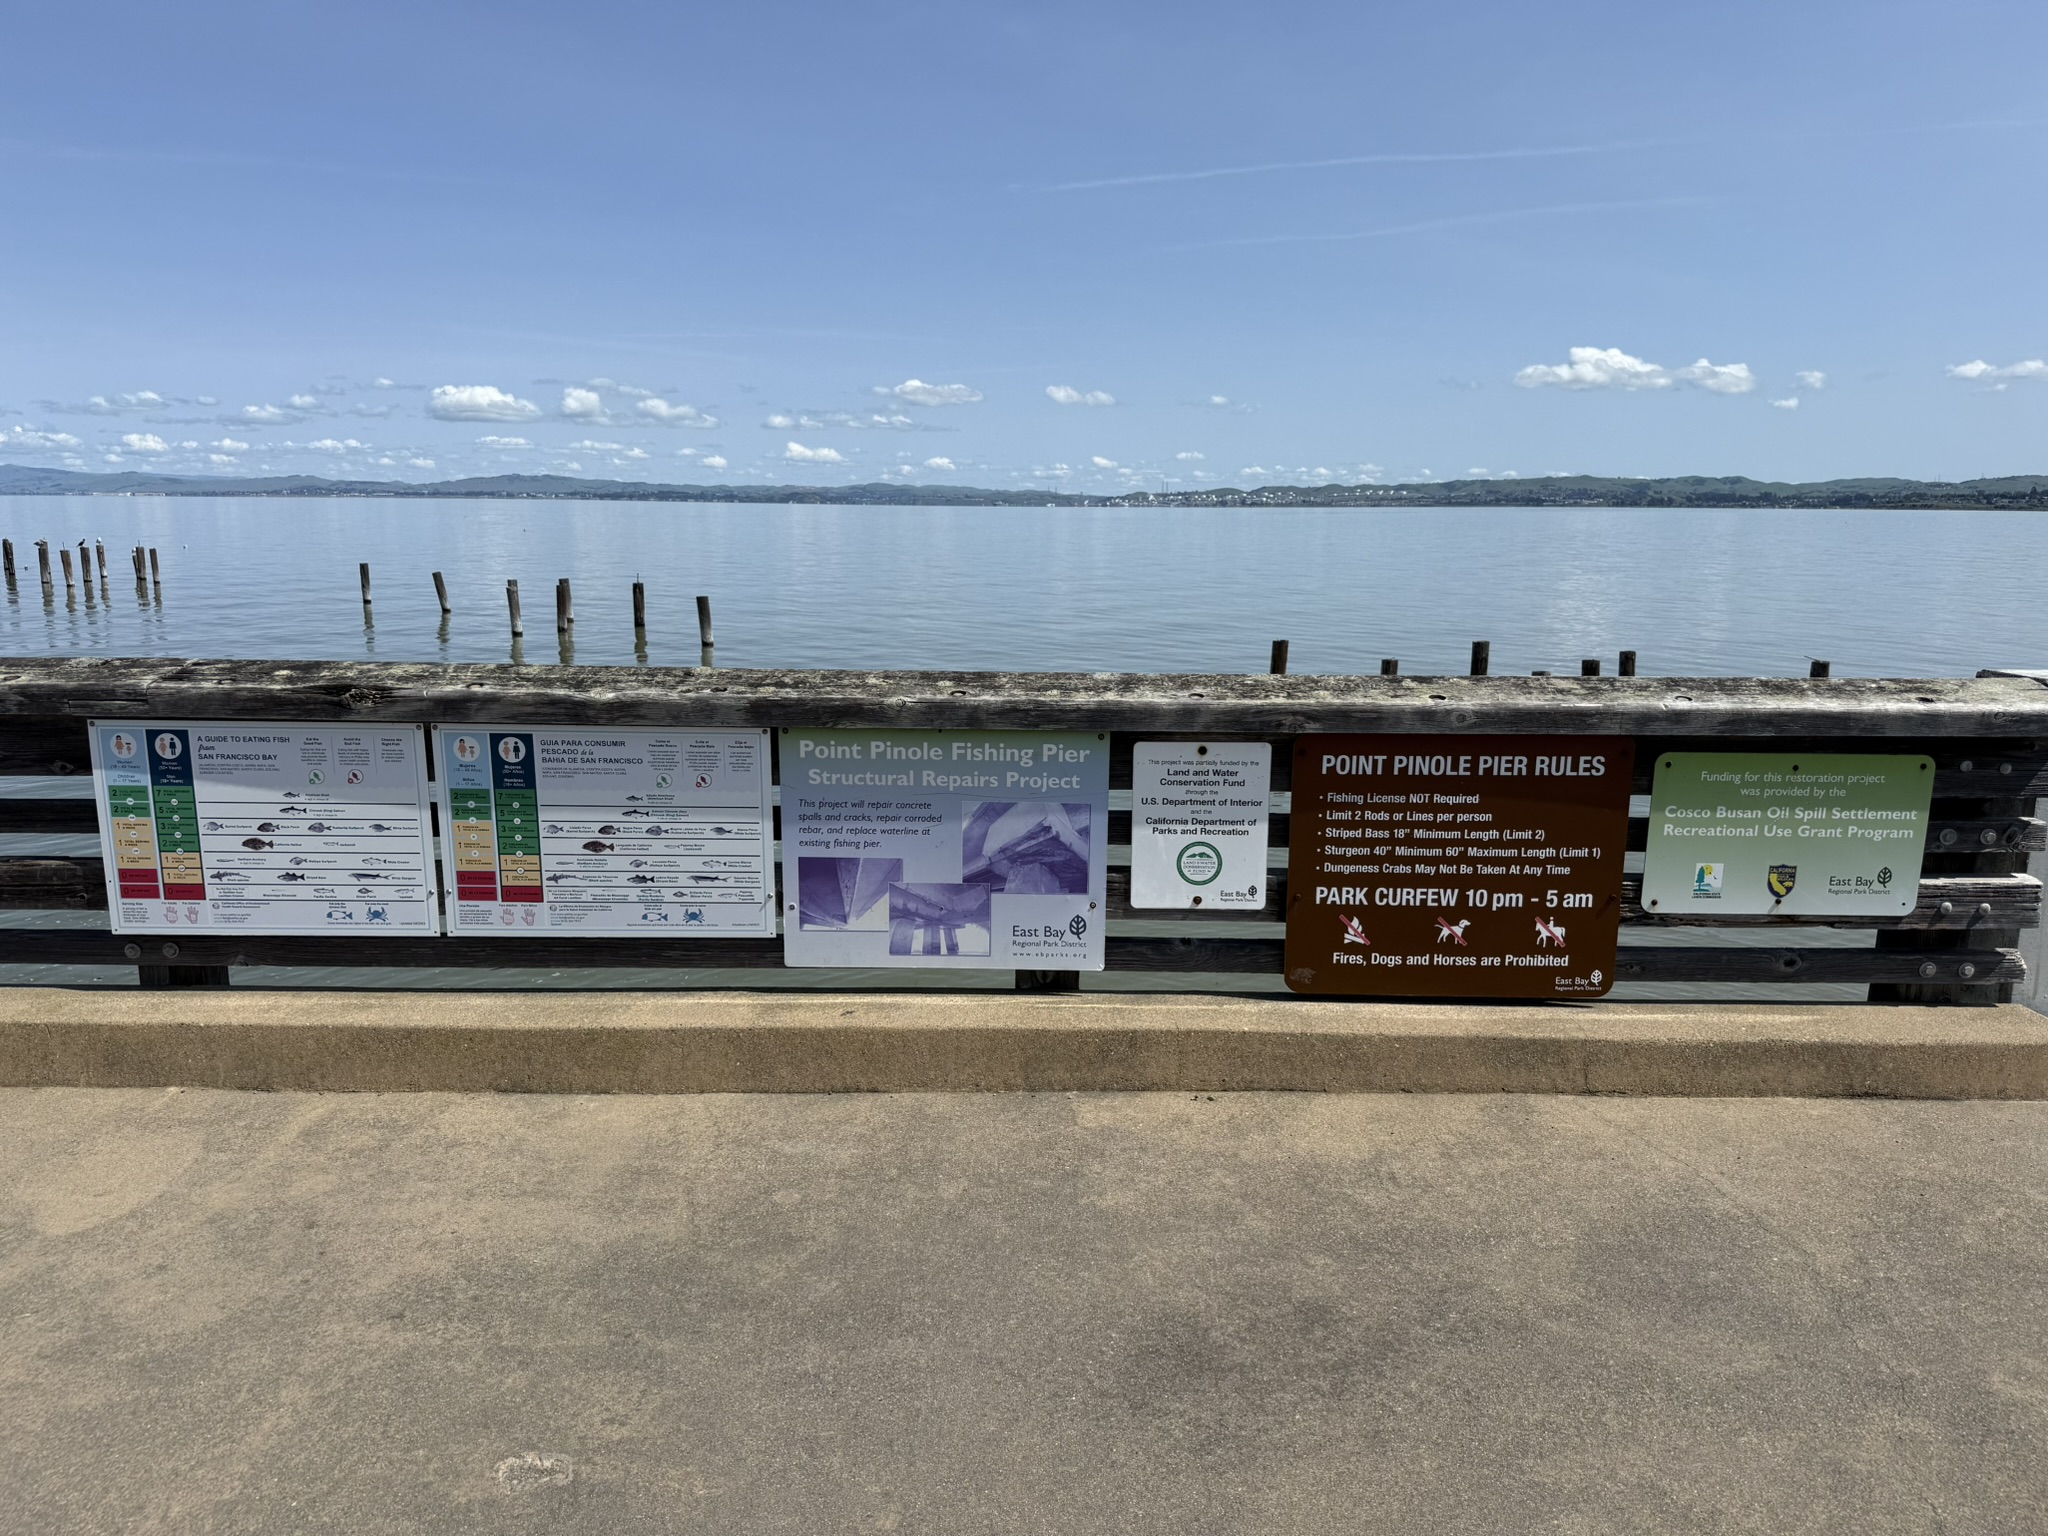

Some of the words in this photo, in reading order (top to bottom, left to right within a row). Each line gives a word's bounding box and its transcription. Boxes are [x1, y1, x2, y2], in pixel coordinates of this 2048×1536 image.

[197, 736, 203, 745] A
[204, 735, 229, 743] GUIDE
[799, 740, 862, 759] Point
[870, 742, 943, 760] Pinole
[951, 743, 1034, 765] Fishing
[1042, 744, 1091, 763] Pier
[598, 757, 643, 765] FRANCISCO
[1322, 755, 1387, 775] POINT
[1393, 756, 1472, 776] PINOLE
[1478, 756, 1528, 776] PIER
[1535, 756, 1606, 776] RULES
[1167, 768, 1190, 776] Land
[1192, 769, 1210, 777] and
[1212, 769, 1239, 777] Water
[1701, 771, 1742, 785] Funding
[1744, 771, 1761, 782] for
[1763, 772, 1782, 783] this
[1785, 773, 1844, 783] restoration
[1847, 774, 1885, 786] project
[808, 769, 914, 786] Structural
[922, 771, 999, 792] Repairs
[1006, 772, 1081, 793] Project
[1159, 778, 1220, 787] Conservation
[1222, 778, 1246, 787] Fund
[1327, 792, 1364, 805] Fishing
[1367, 793, 1406, 803] License
[1409, 793, 1431, 804] NOT
[1433, 793, 1480, 806] Required
[1740, 788, 1761, 796] was
[1763, 786, 1810, 799] provided
[1813, 786, 1826, 799] by
[1829, 787, 1846, 797] the
[798, 799, 816, 808] This
[818, 799, 848, 811] project
[850, 800, 865, 809] will
[867, 800, 893, 811] repair
[895, 802, 932, 810] concrete
[1141, 797, 1159, 806] U.S.
[1162, 798, 1216, 808] Department
[1218, 798, 1228, 807] of
[1230, 799, 1263, 807] Interior
[798, 812, 822, 823] spalls
[824, 812, 842, 822] and
[843, 812, 873, 823] cracks,
[876, 813, 902, 824] repair
[904, 814, 943, 823] corroded
[1326, 810, 1352, 820] Limit
[1354, 810, 1362, 821] 2
[1364, 810, 1390, 821] Rods
[1392, 813, 1404, 821] or
[1406, 811, 1434, 822] Lines
[1436, 813, 1455, 824] per
[1456, 813, 1492, 824] person
[1665, 806, 1711, 818] Cosco
[1715, 806, 1762, 819] Busan
[1767, 807, 1789, 820] Oil
[1794, 807, 1826, 822] Spill
[1831, 808, 1917, 820] Settlement
[1145, 817, 1189, 825] California
[1191, 818, 1245, 827] Department
[1247, 818, 1257, 827] of
[798, 825, 824, 835] rebar,
[826, 825, 844, 835] and
[845, 826, 877, 837] replace
[879, 826, 919, 836] waterline
[921, 828, 931, 836] at
[1152, 827, 1178, 835] Parks
[1180, 827, 1198, 835] and
[1200, 828, 1249, 836] Recreation
[1325, 827, 1362, 840] Striped
[1365, 828, 1390, 839] Bass
[1413, 829, 1461, 839] Minimum
[1464, 829, 1500, 842] Length
[1502, 829, 1533, 842] (Limit
[1535, 829, 1545, 842] 2)
[1663, 824, 1759, 837] Recreational
[1764, 825, 1792, 837] Use
[1797, 825, 1843, 838] Grant
[1847, 826, 1914, 842] Program
[798, 839, 831, 850] existing
[833, 838, 861, 850] fishing
[863, 840, 882, 850] pier.
[1324, 845, 1371, 858] Sturgeon
[1395, 846, 1443, 857] Minimum
[1467, 847, 1518, 857] Maximum
[1521, 847, 1556, 860] Length
[1559, 847, 1589, 859] (Limit
[1592, 847, 1601, 860] 1)
[1324, 863, 1380, 875] Dungeness
[1382, 863, 1412, 874] Crabs
[1414, 864, 1437, 876] May
[1439, 864, 1457, 874] Not
[1459, 864, 1473, 874] Be
[1476, 864, 1506, 875] Taken
[1509, 864, 1521, 875] At
[1523, 865, 1543, 877] Any
[1546, 865, 1571, 875] Time
[1829, 876, 1852, 887] East
[1855, 876, 1875, 889] Bay
[1828, 888, 1853, 896] Regional
[1316, 887, 1368, 905] PARK
[1375, 888, 1459, 906] CURFEW
[1465, 889, 1488, 907] 10
[1492, 893, 1523, 911] pm
[1545, 890, 1558, 908] 5
[1562, 893, 1593, 908] am
[1012, 925, 1039, 938] East
[1044, 926, 1066, 941] Bay
[1012, 940, 1041, 948] Regional
[1061, 940, 1087, 948] District
[1333, 952, 1367, 966] Fires,
[1371, 953, 1402, 968] Dogs
[1406, 953, 1430, 966] and
[1433, 954, 1477, 966] Horses
[1480, 957, 1501, 966] are
[1505, 954, 1569, 967] Prohibited
[1555, 976, 1573, 985] East
[1575, 977, 1589, 986] Bay
